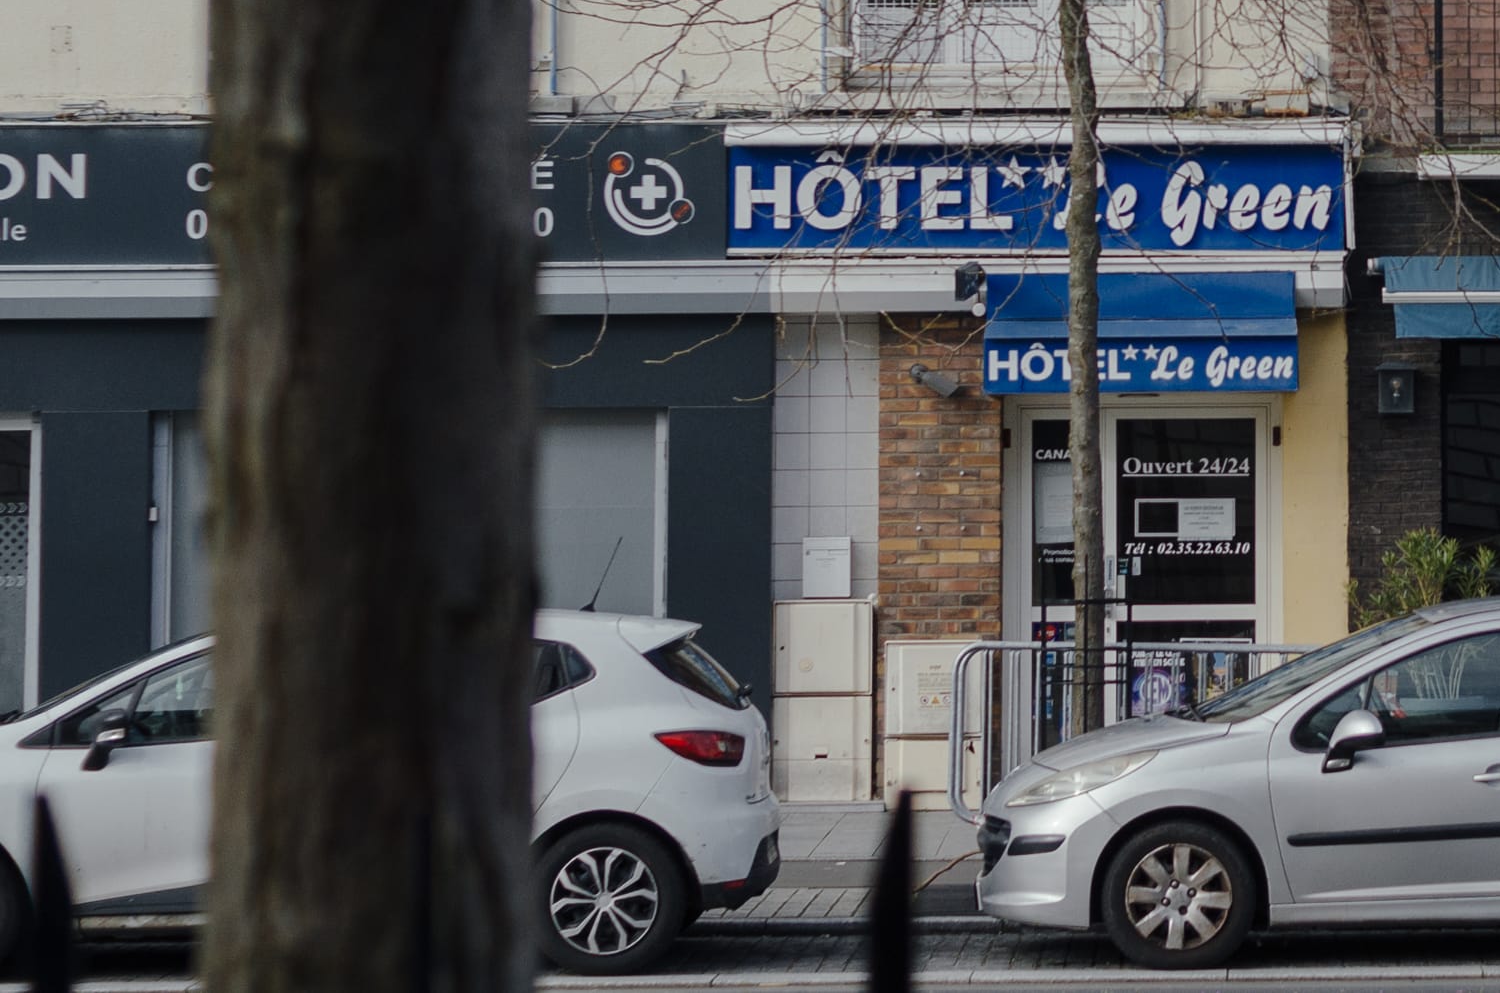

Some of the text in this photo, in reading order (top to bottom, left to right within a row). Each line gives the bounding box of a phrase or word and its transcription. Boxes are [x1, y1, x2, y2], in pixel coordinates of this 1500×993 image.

[733, 150, 1013, 231] HÔTEL
[1161, 160, 1333, 247] Green
[0, 216, 28, 241] le
[987, 342, 1294, 388] HÔTL Le Green
[1123, 456, 1250, 475] Ouvert 24/24
[1124, 542, 1146, 555] Tél
[1156, 541, 1251, 555] 02.35.22.63.10
